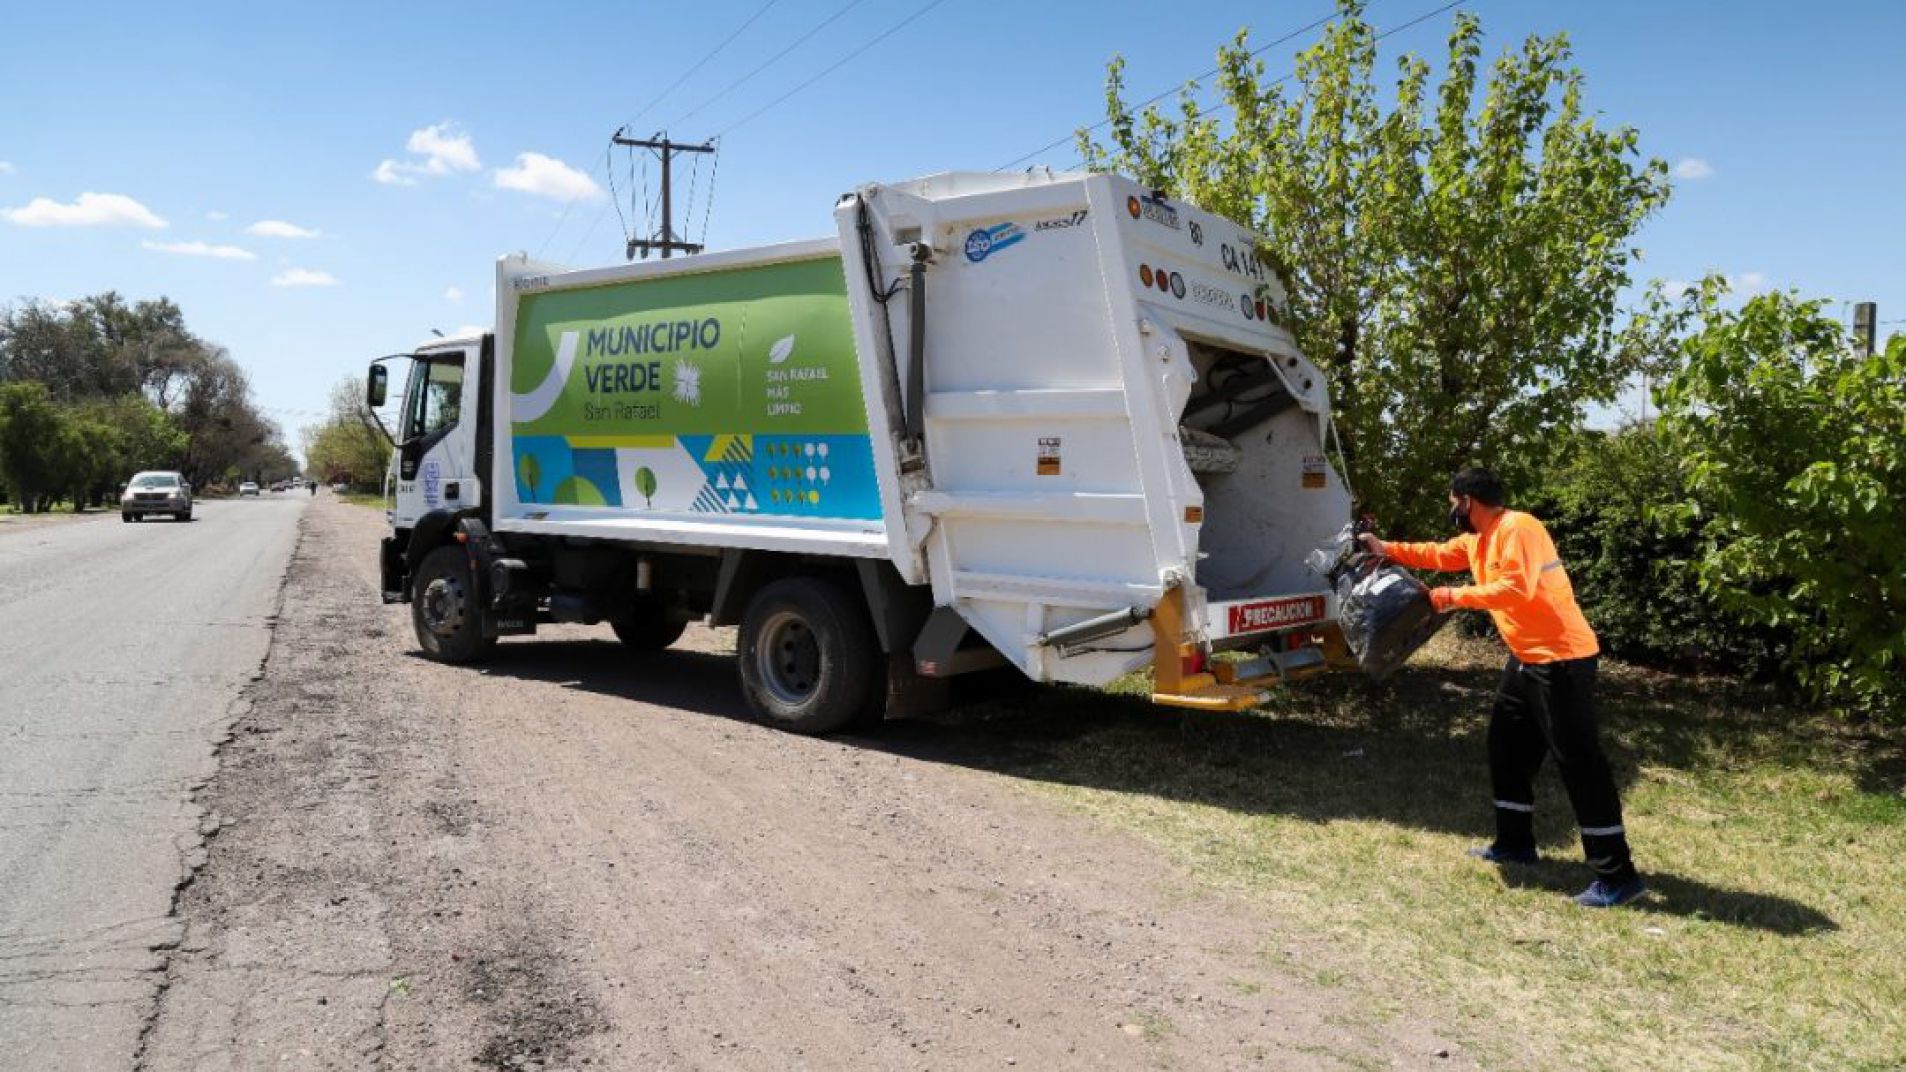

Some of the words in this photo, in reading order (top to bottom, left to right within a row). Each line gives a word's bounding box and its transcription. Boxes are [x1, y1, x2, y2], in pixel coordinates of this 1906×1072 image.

[1221, 243, 1241, 275] CA
[586, 317, 721, 357] MUNICIPIO
[585, 361, 662, 393] VERDE
[584, 401, 610, 421] San
[614, 401, 662, 420] Rafael
